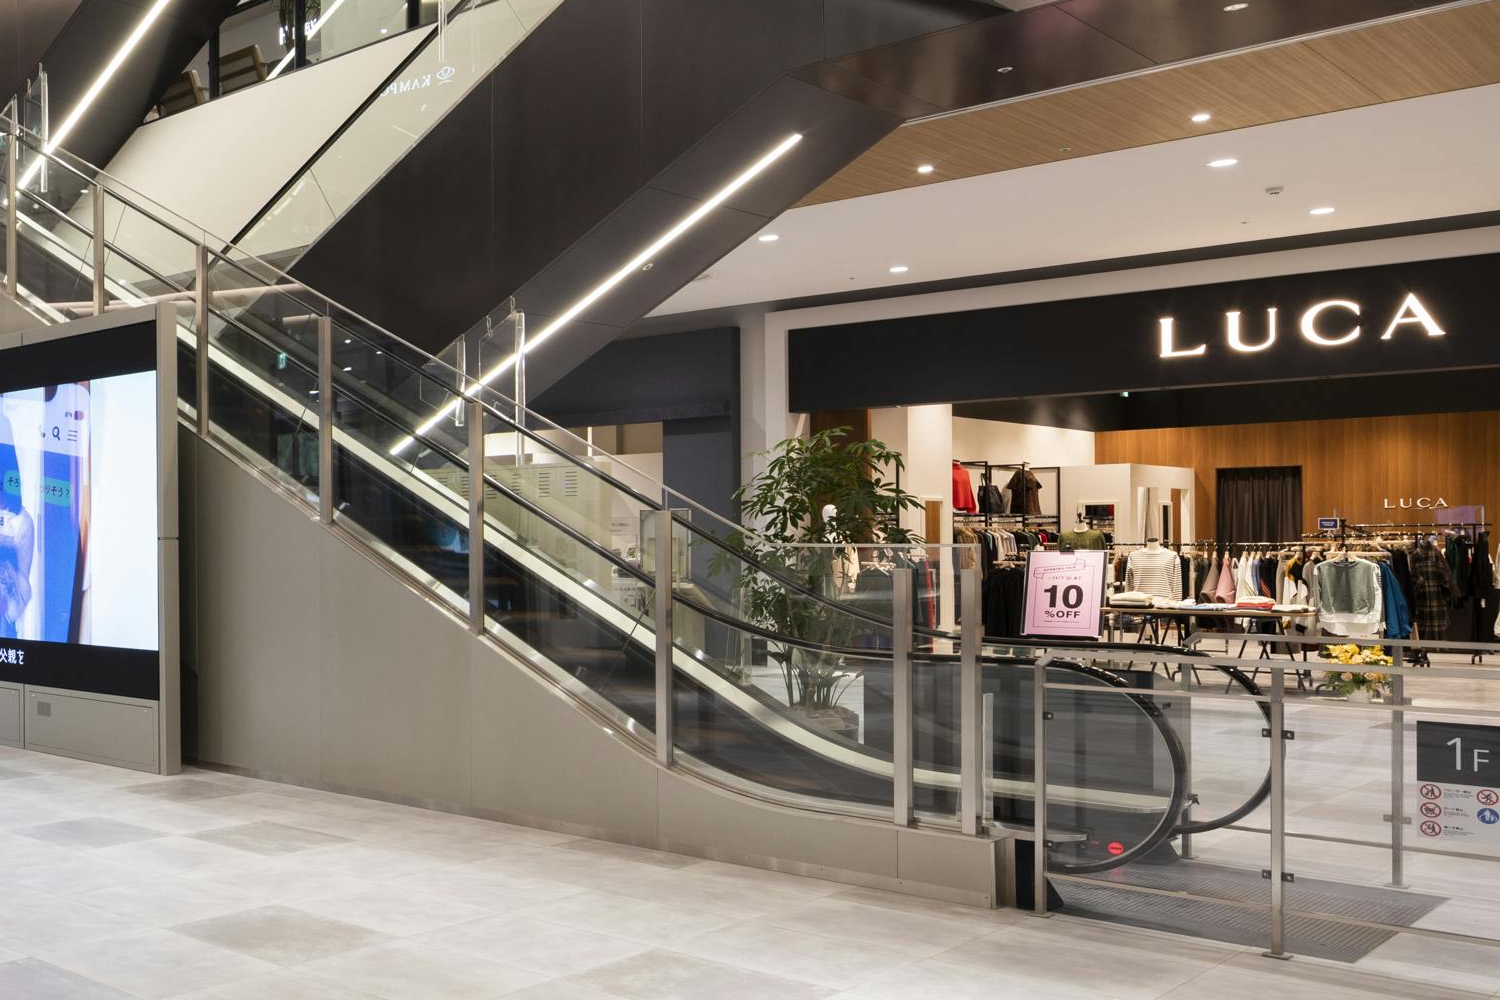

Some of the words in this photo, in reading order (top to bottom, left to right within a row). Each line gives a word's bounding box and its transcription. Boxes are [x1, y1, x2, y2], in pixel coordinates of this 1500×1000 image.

[1159, 292, 1447, 358] LUCA
[1384, 497, 1449, 509] LUCA
[1043, 584, 1084, 609] 10
[1044, 610, 1081, 619] %OFF
[1446, 737, 1490, 773] 1F
